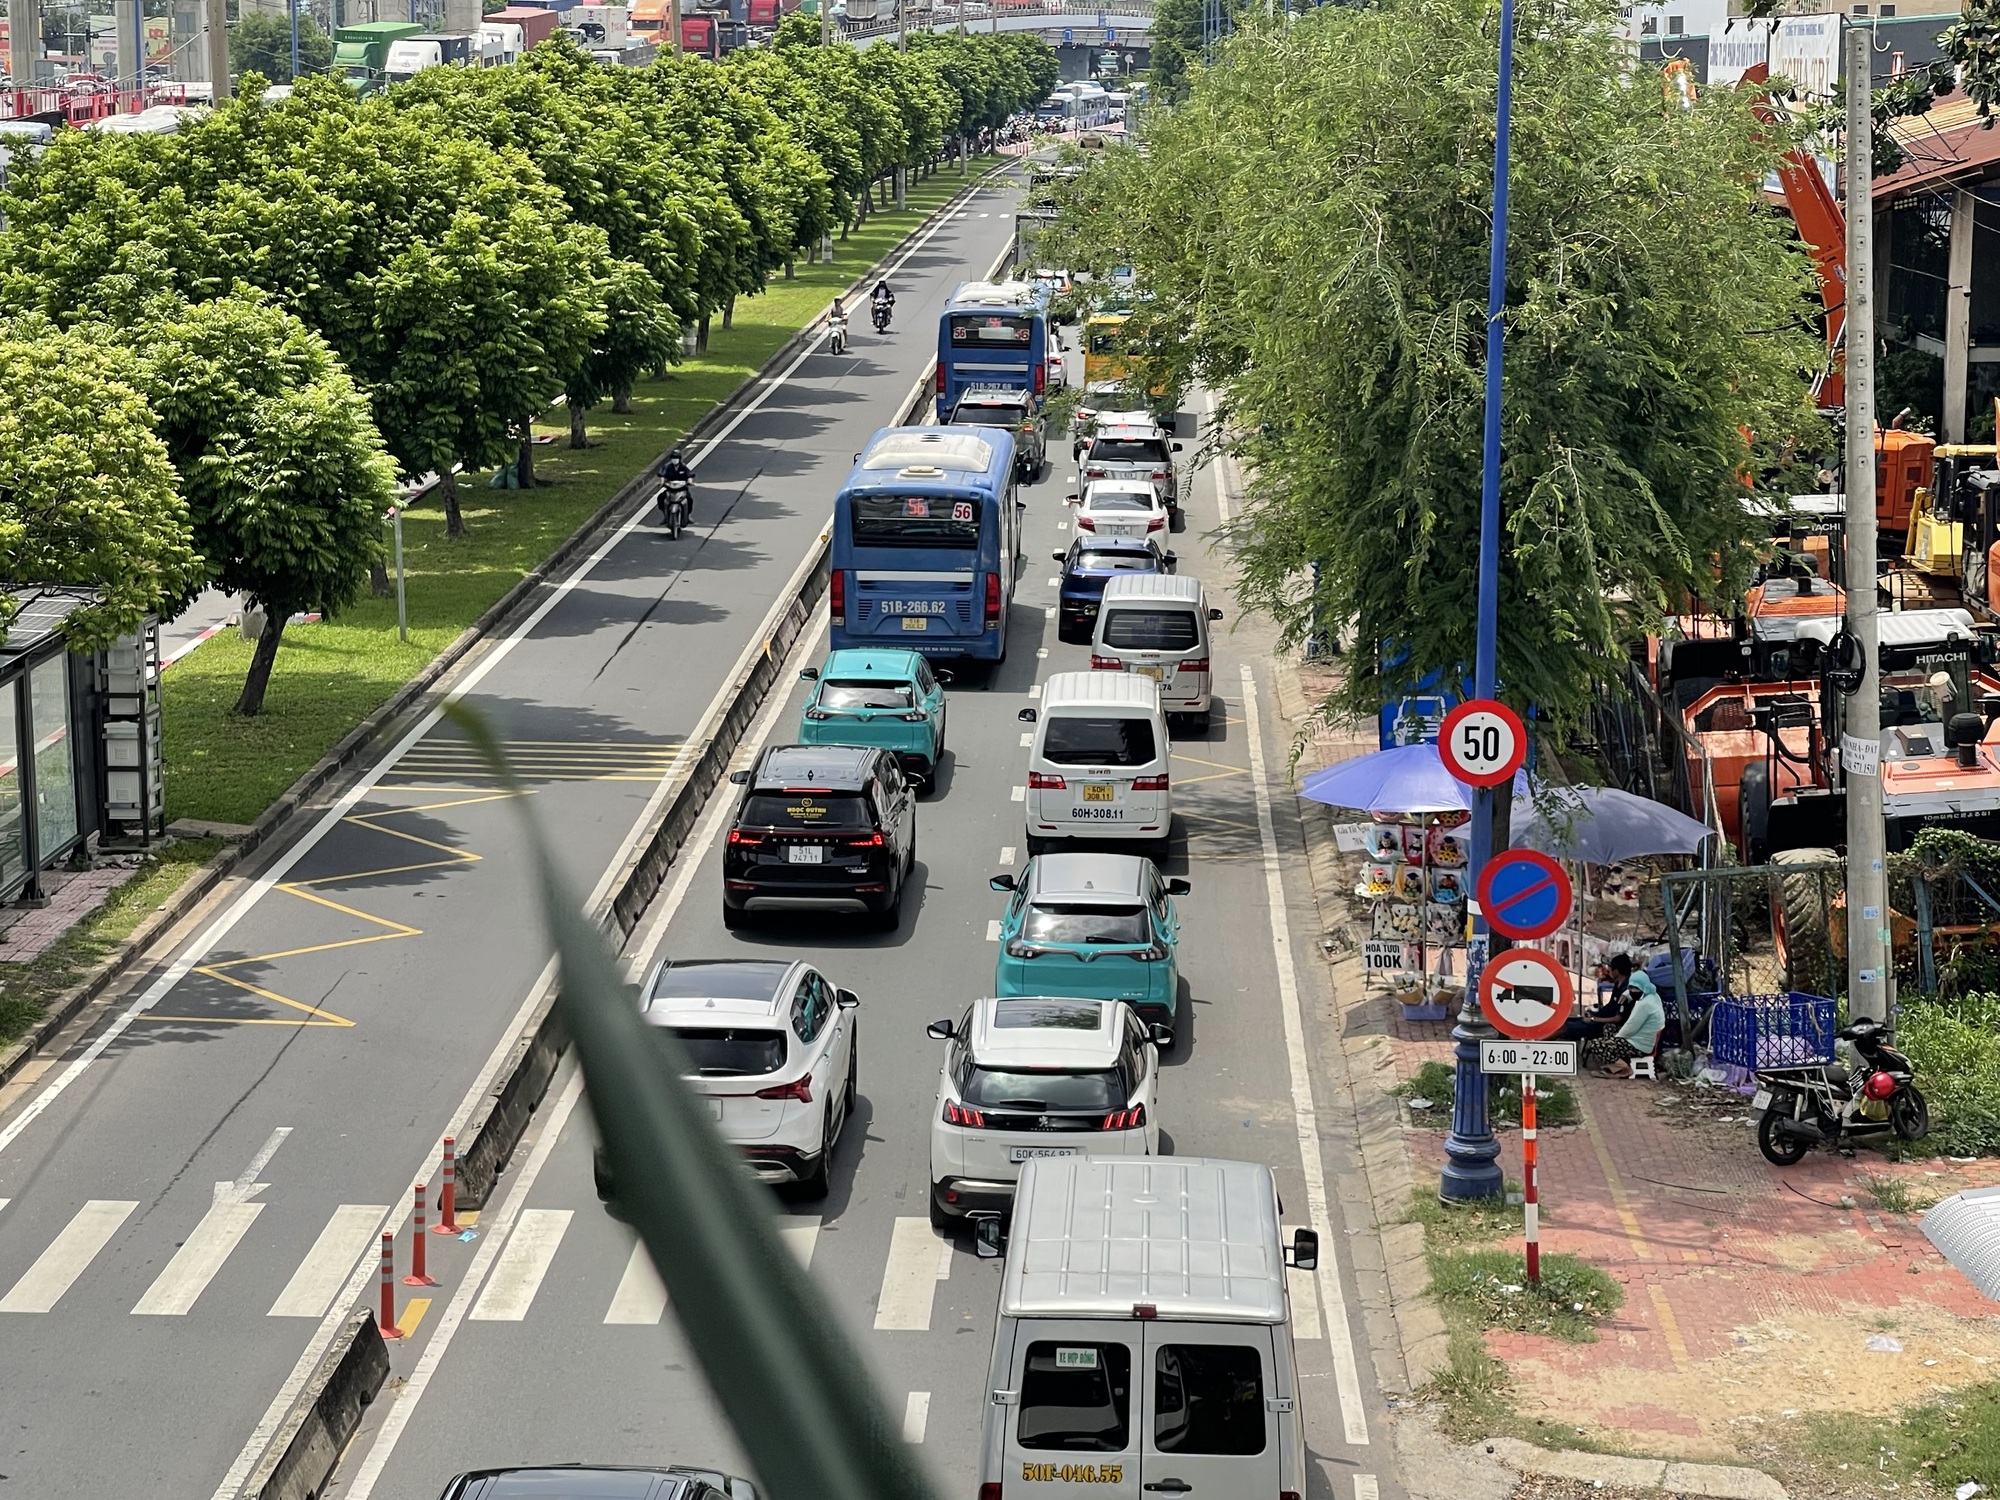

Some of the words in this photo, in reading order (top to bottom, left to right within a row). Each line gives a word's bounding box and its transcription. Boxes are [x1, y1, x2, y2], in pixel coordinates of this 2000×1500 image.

[954, 328, 965, 338] 56
[1015, 329, 1029, 340] 56
[907, 498, 926, 516] 56
[954, 504, 971, 520] 56
[881, 600, 946, 614] 51B-266.62
[1916, 652, 1967, 665] HITACHI
[1463, 725, 1500, 762] 50
[1072, 807, 1123, 819] 60H-308.11
[793, 854, 818, 862] 747.11
[1365, 943, 1382, 953] HOA
[1364, 954, 1403, 969] 100K
[1488, 1049, 1517, 1064] 6:00
[1532, 1050, 1569, 1066] 22:00
[1059, 1352, 1067, 1364] XE
[1022, 1462, 1123, 1484] 50F-046.55
